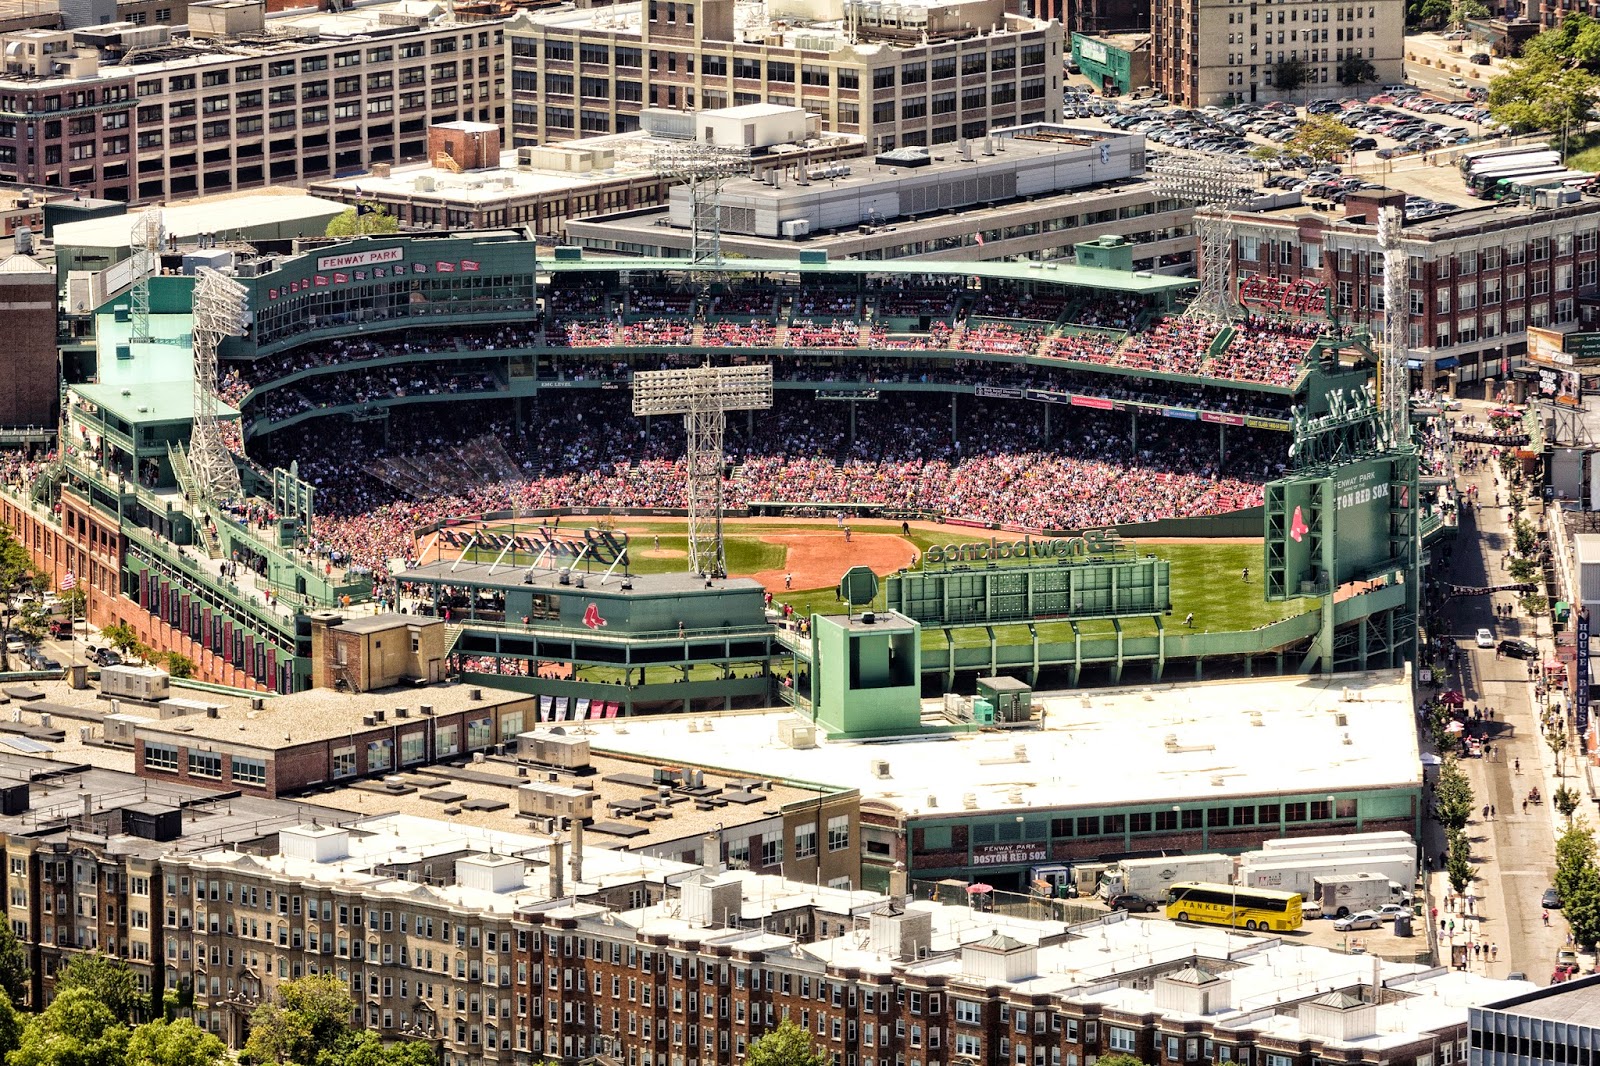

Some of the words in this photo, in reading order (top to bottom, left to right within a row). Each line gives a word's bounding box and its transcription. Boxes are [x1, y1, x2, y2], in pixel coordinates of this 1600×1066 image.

[323, 254, 365, 268] FENWAY
[370, 250, 398, 260] PARK
[1539, 369, 1557, 380] GRAB
[1539, 380, 1557, 391] BUDS
[1333, 477, 1357, 489] FENWAY
[1359, 472, 1376, 483] PARK
[1355, 488, 1371, 505] RED
[1372, 483, 1389, 500] SOX
[1578, 623, 1588, 666] HOUSE
[1578, 679, 1588, 722] BLUES
[973, 853, 1008, 865] BOSTON
[1010, 852, 1027, 862] RED
[1028, 850, 1047, 861] SOX
[1182, 901, 1226, 912] YANKEE
